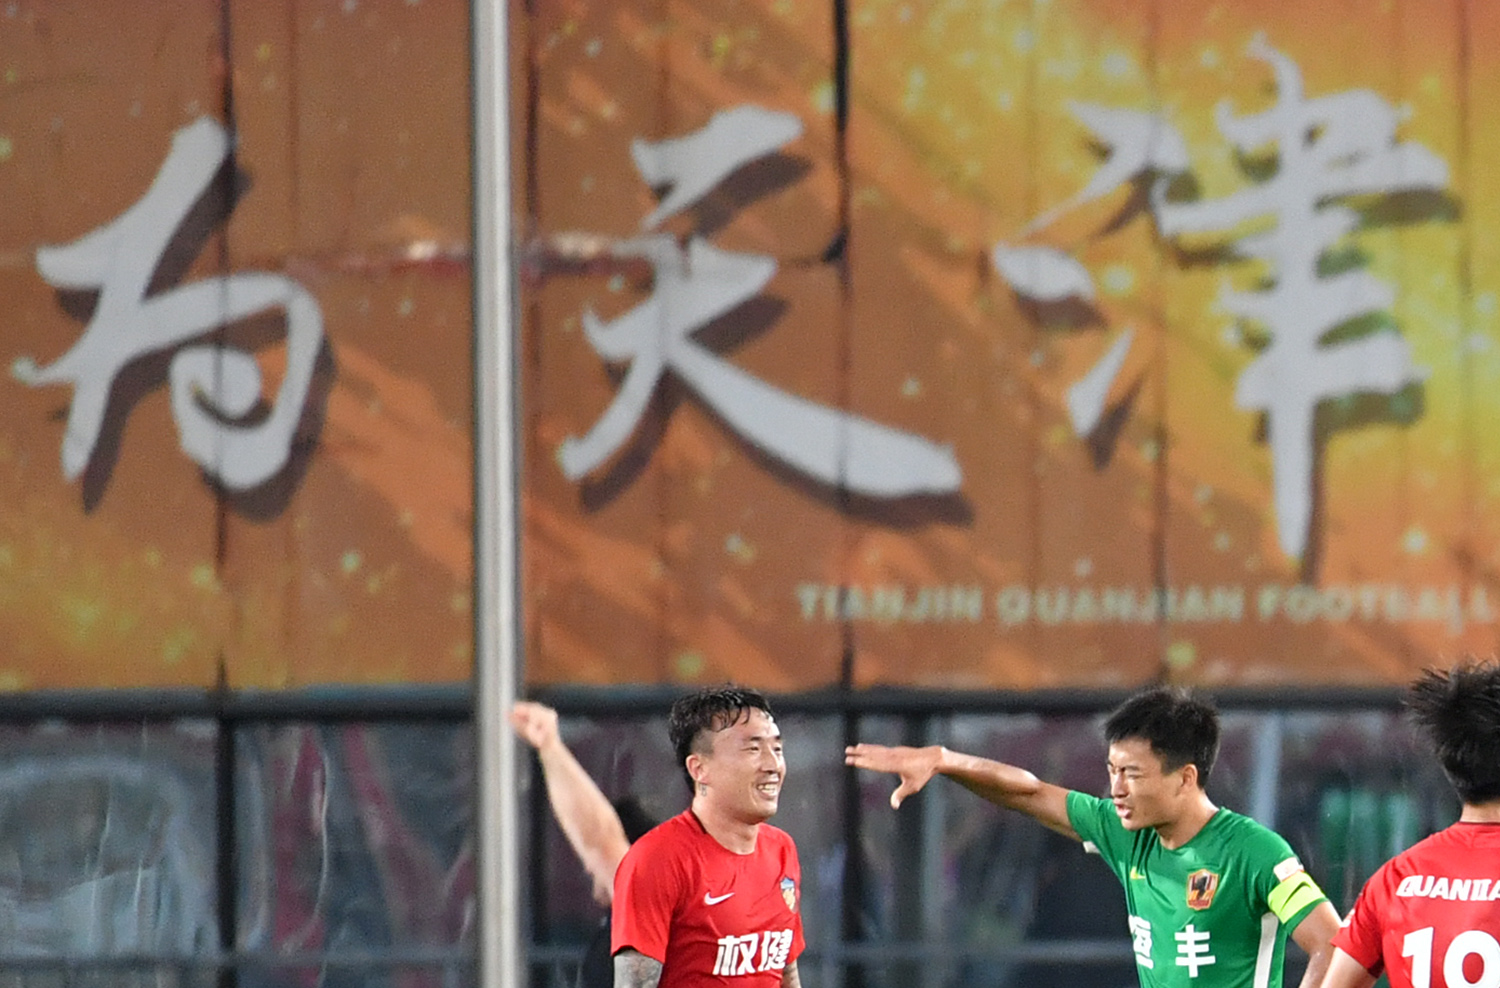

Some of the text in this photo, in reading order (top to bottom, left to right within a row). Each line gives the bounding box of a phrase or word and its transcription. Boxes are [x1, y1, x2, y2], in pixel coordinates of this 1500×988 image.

[798, 580, 983, 622] TIANJIN
[1257, 583, 1495, 624] FOOTBALL
[712, 929, 793, 976] 权健
